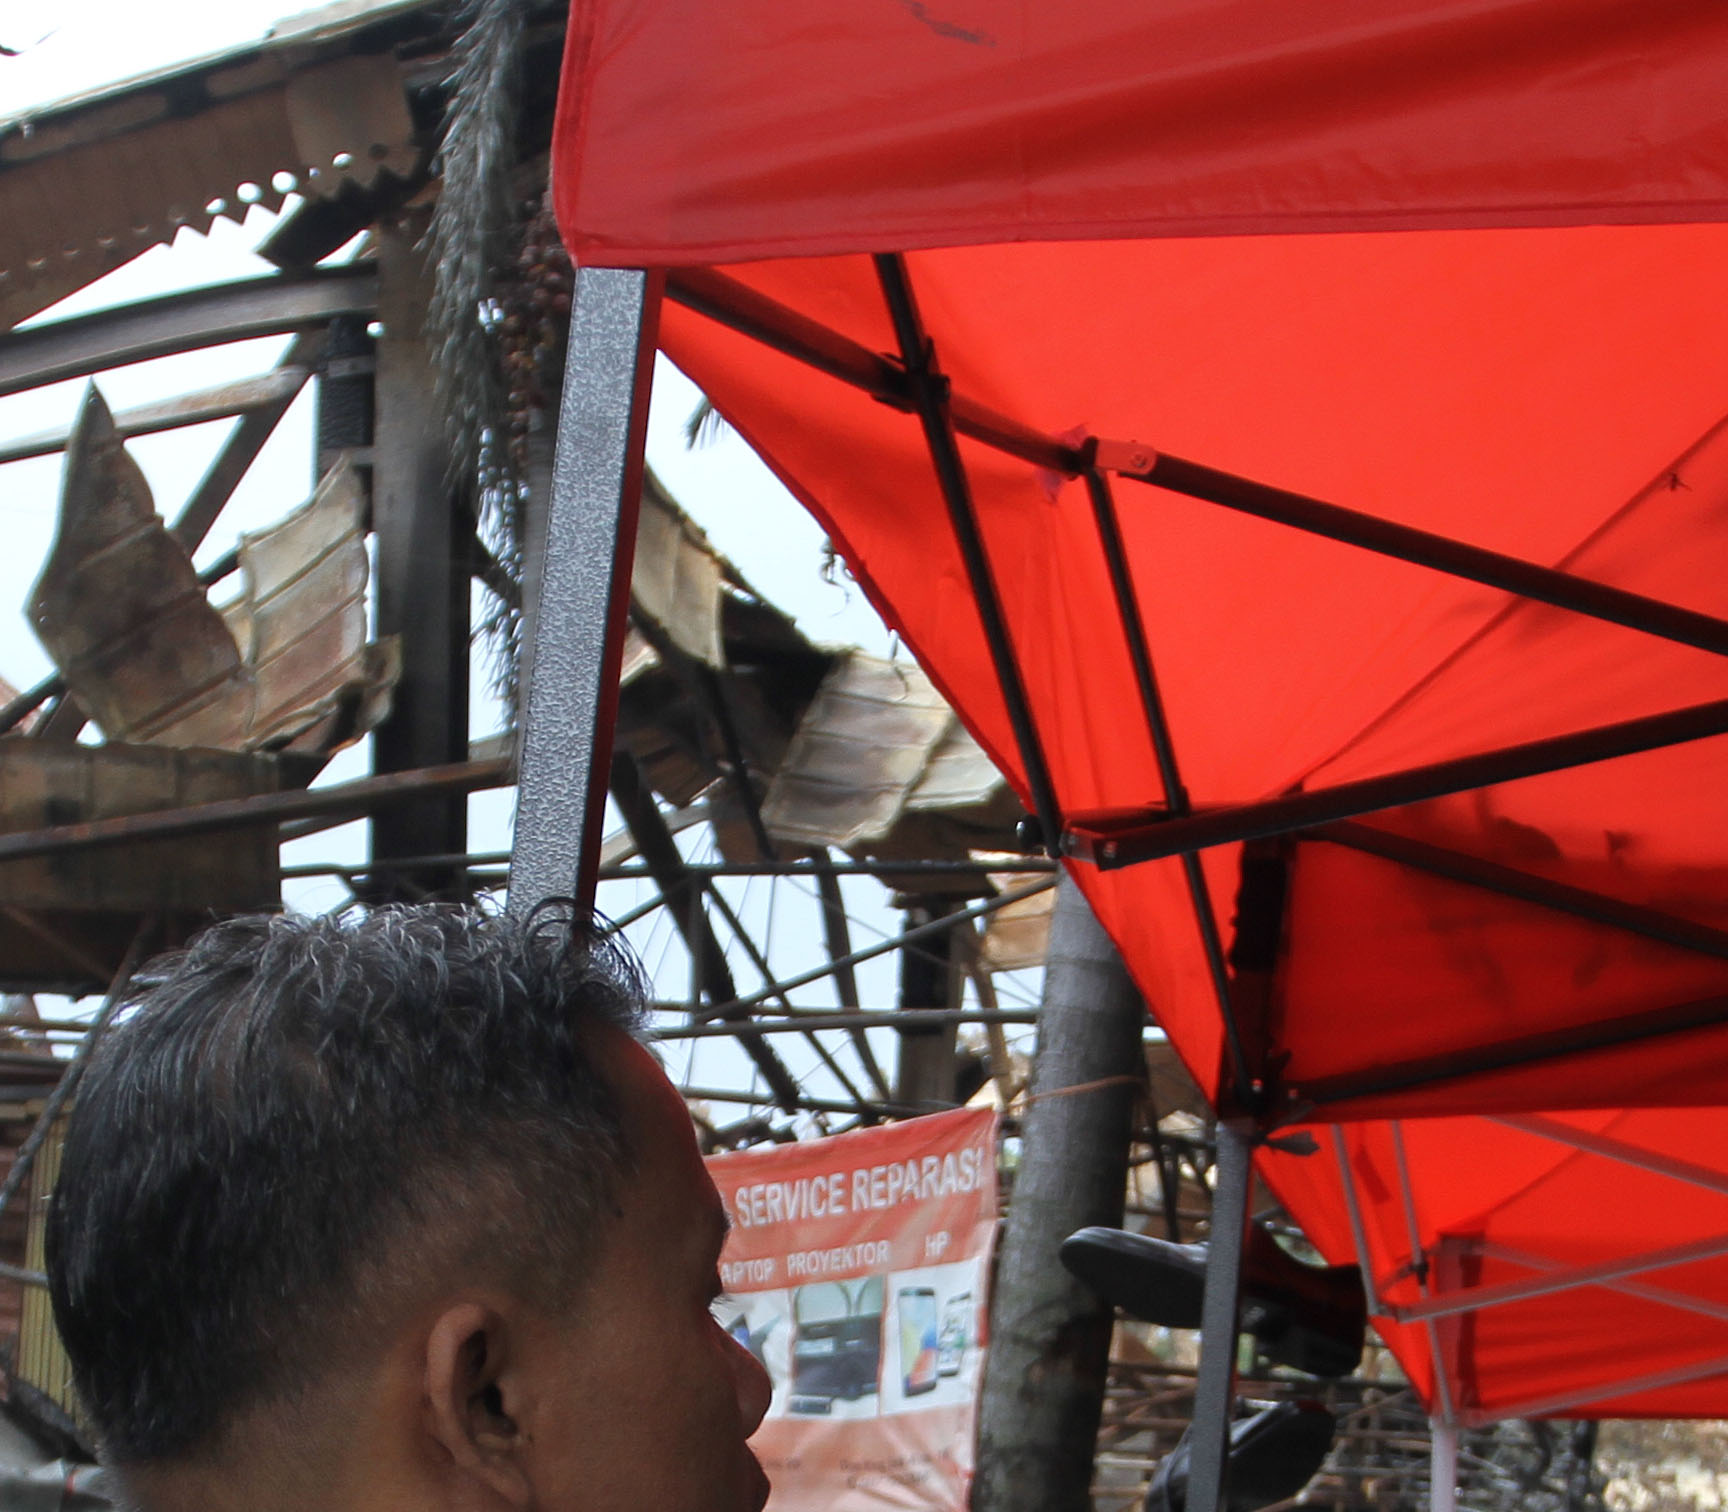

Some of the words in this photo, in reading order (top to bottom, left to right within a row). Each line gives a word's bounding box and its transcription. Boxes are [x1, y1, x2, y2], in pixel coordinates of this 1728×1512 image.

[735, 1172, 846, 1229] SERVICE
[720, 1257, 775, 1285] APTOP
[786, 1239, 890, 1276] PROYEKTOR
[924, 1231, 950, 1257] HP
